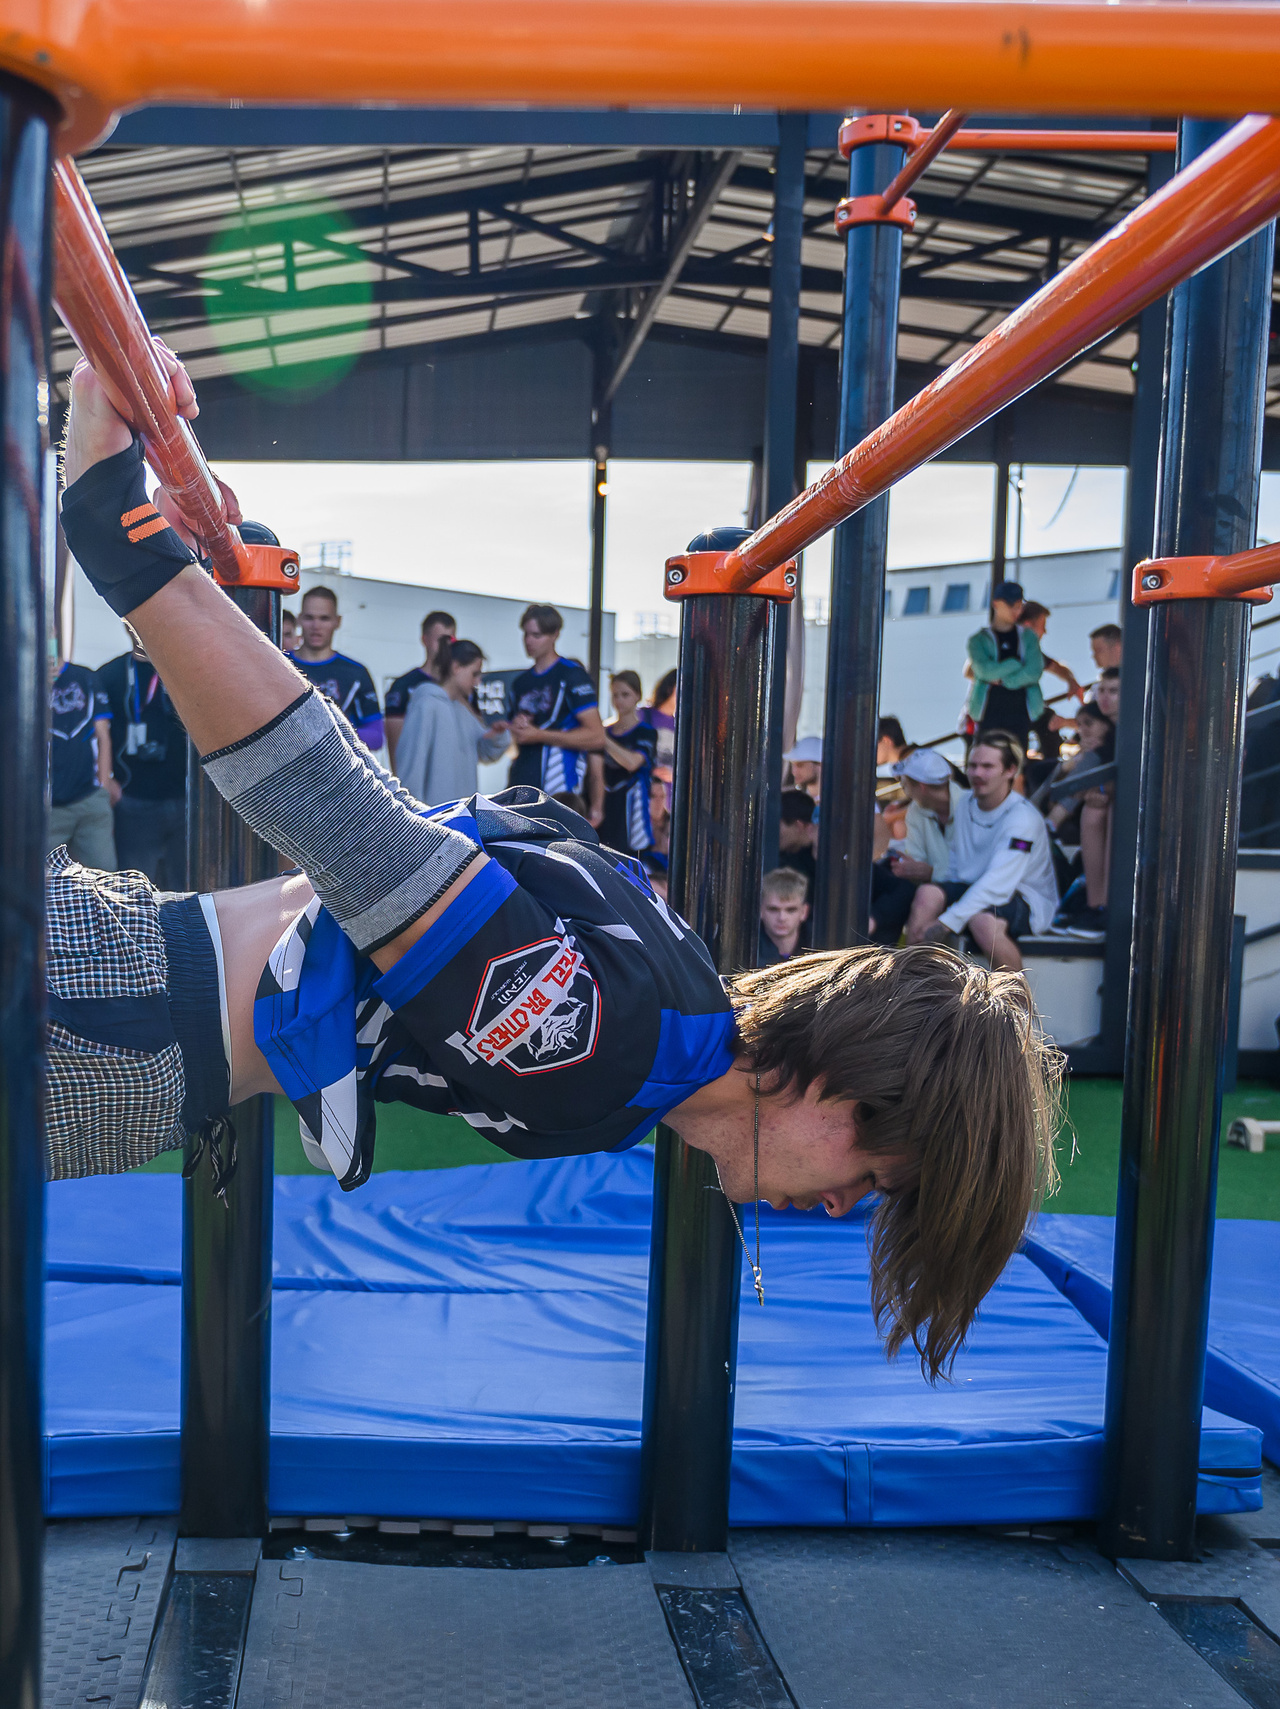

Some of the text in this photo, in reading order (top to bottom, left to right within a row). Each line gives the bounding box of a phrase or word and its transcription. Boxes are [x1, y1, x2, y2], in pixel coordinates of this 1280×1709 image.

[476, 947, 578, 1062] TEEL BROTHERS
[497, 972, 532, 1005] TEAM
